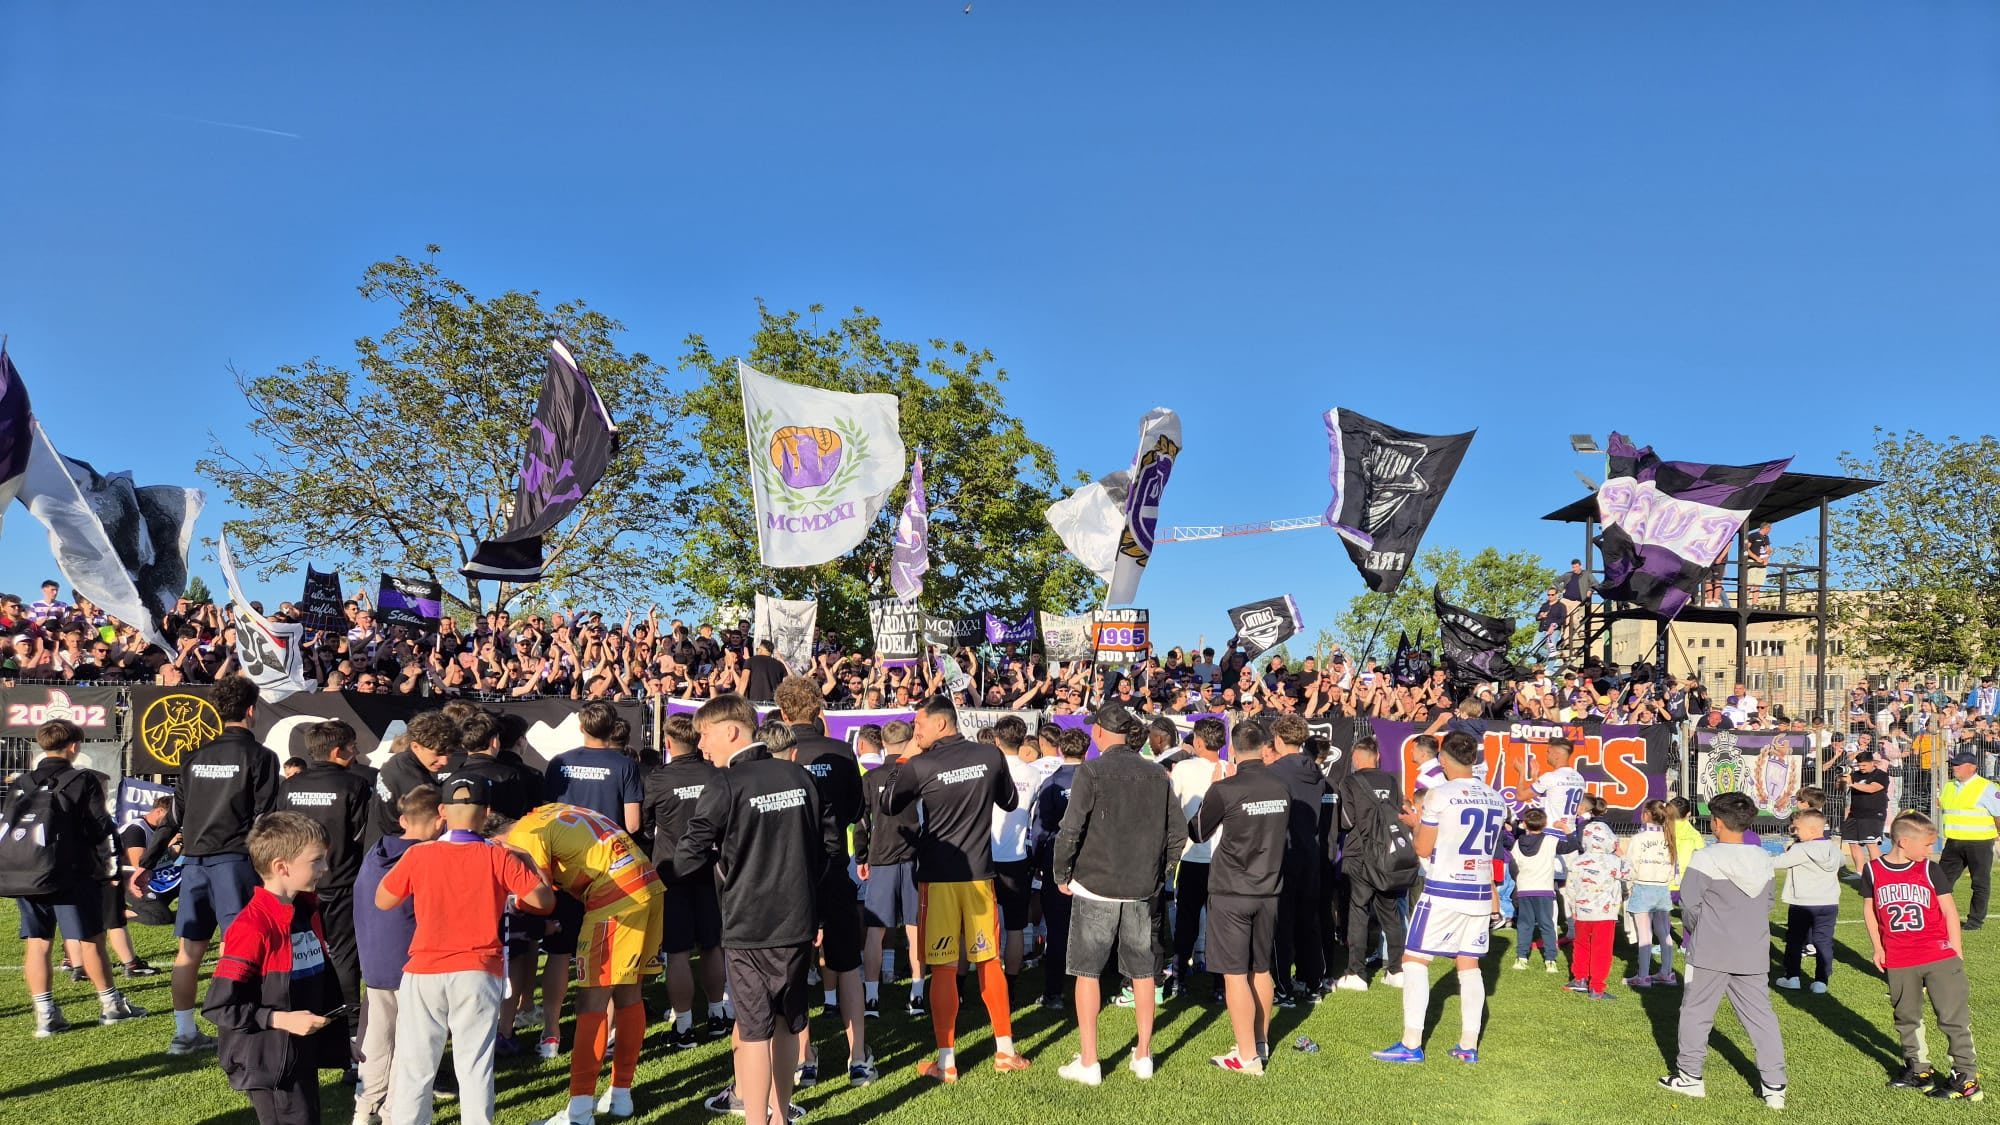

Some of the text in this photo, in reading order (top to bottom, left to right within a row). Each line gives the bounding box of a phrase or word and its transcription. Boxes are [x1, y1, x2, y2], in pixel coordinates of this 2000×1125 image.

[767, 501, 857, 533] MCMXXI
[1095, 610, 1147, 622] PELUZA
[1246, 611, 1271, 628] ULTRAS
[924, 618, 981, 632] MCMXXI
[1098, 628, 1145, 646] 1995
[1097, 651, 1123, 662] SUD
[1511, 723, 1562, 738] SOTTO
[560, 765, 610, 775] POLITEHNICA
[937, 764, 988, 781] POLITEHNICA
[288, 792, 336, 800] POLITEHNICA
[750, 788, 807, 807] POLITEHNICA
[1564, 787, 1583, 815] 19
[1242, 799, 1287, 811] POLITEHNICA
[1459, 808, 1502, 856] 25
[1877, 883, 1930, 909] JORDAN
[1887, 903, 1925, 933] 23
